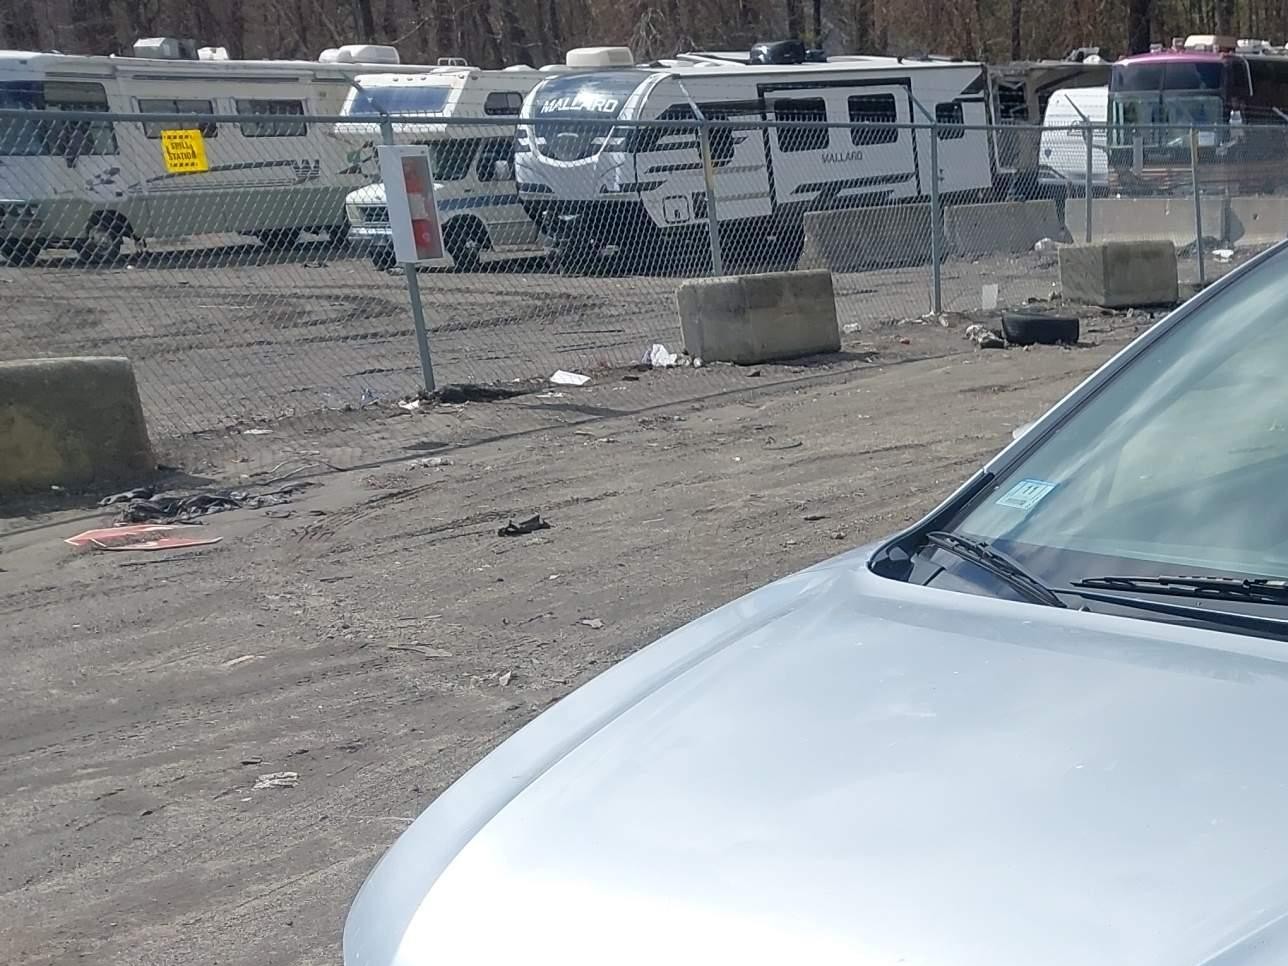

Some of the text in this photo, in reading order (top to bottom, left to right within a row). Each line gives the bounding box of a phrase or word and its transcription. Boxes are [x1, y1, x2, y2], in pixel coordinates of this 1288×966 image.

[540, 97, 618, 114] MALLARD
[170, 141, 191, 150] SPILL
[168, 149, 197, 161] STATION
